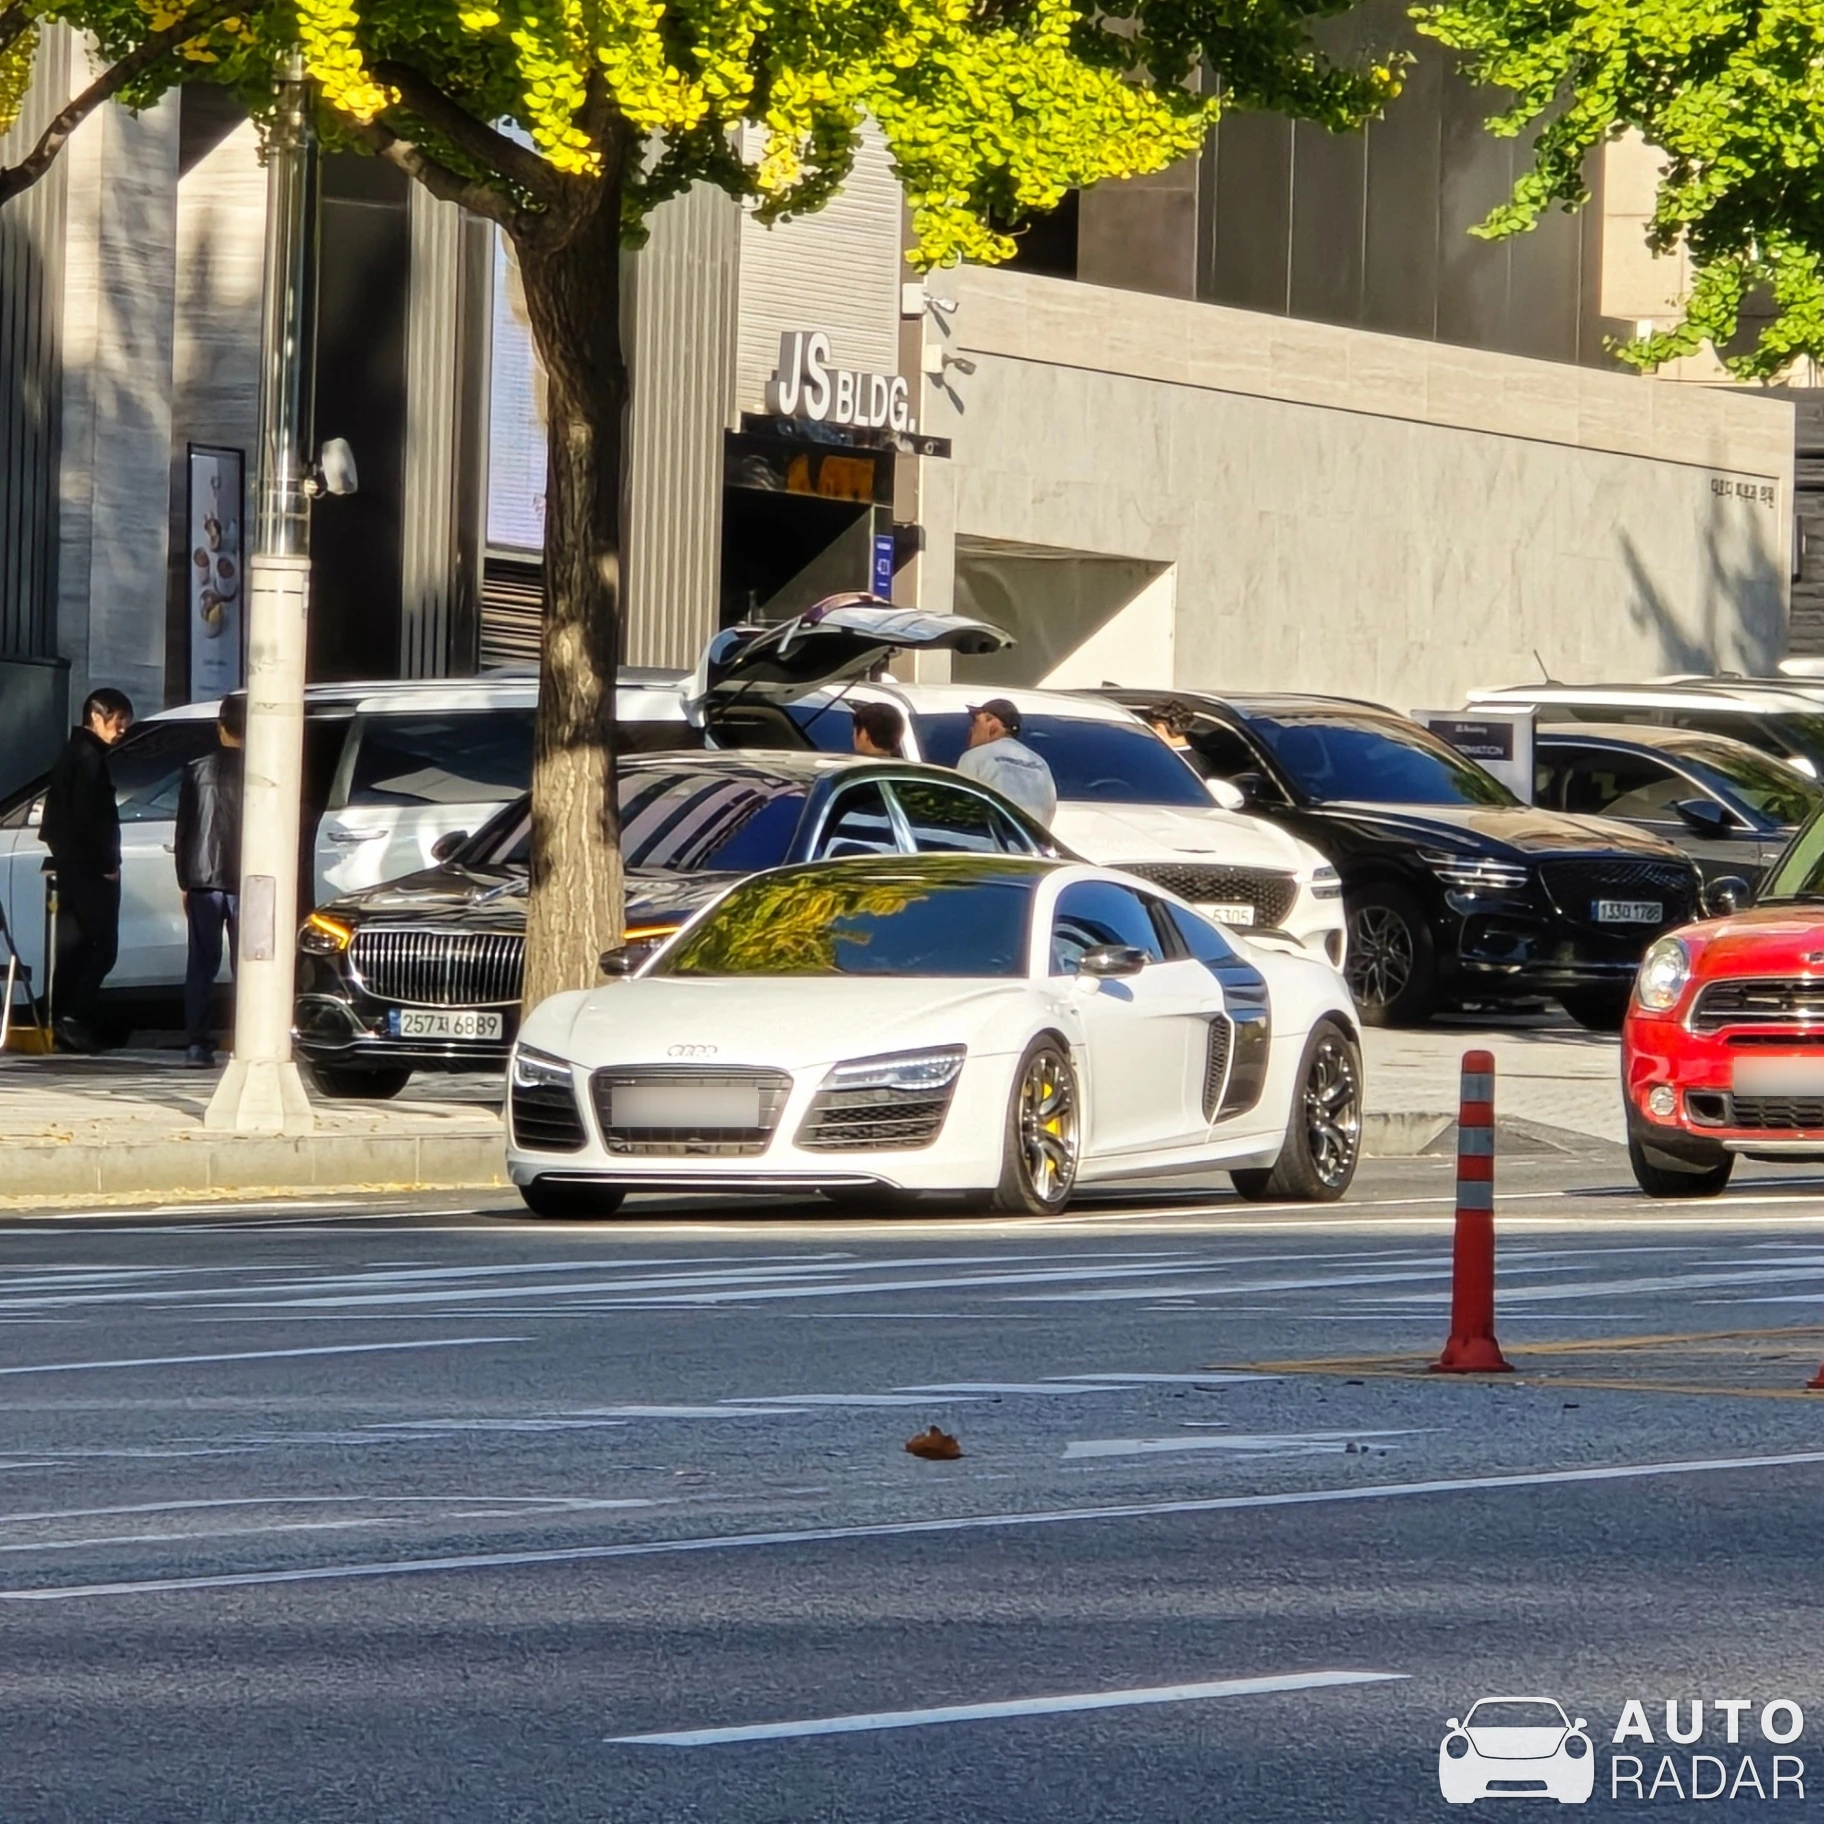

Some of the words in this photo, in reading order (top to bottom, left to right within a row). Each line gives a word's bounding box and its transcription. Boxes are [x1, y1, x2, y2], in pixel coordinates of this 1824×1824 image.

[778, 331, 831, 421] JS
[835, 370, 916, 432] BLDG.
[453, 1016, 498, 1036] 6889
